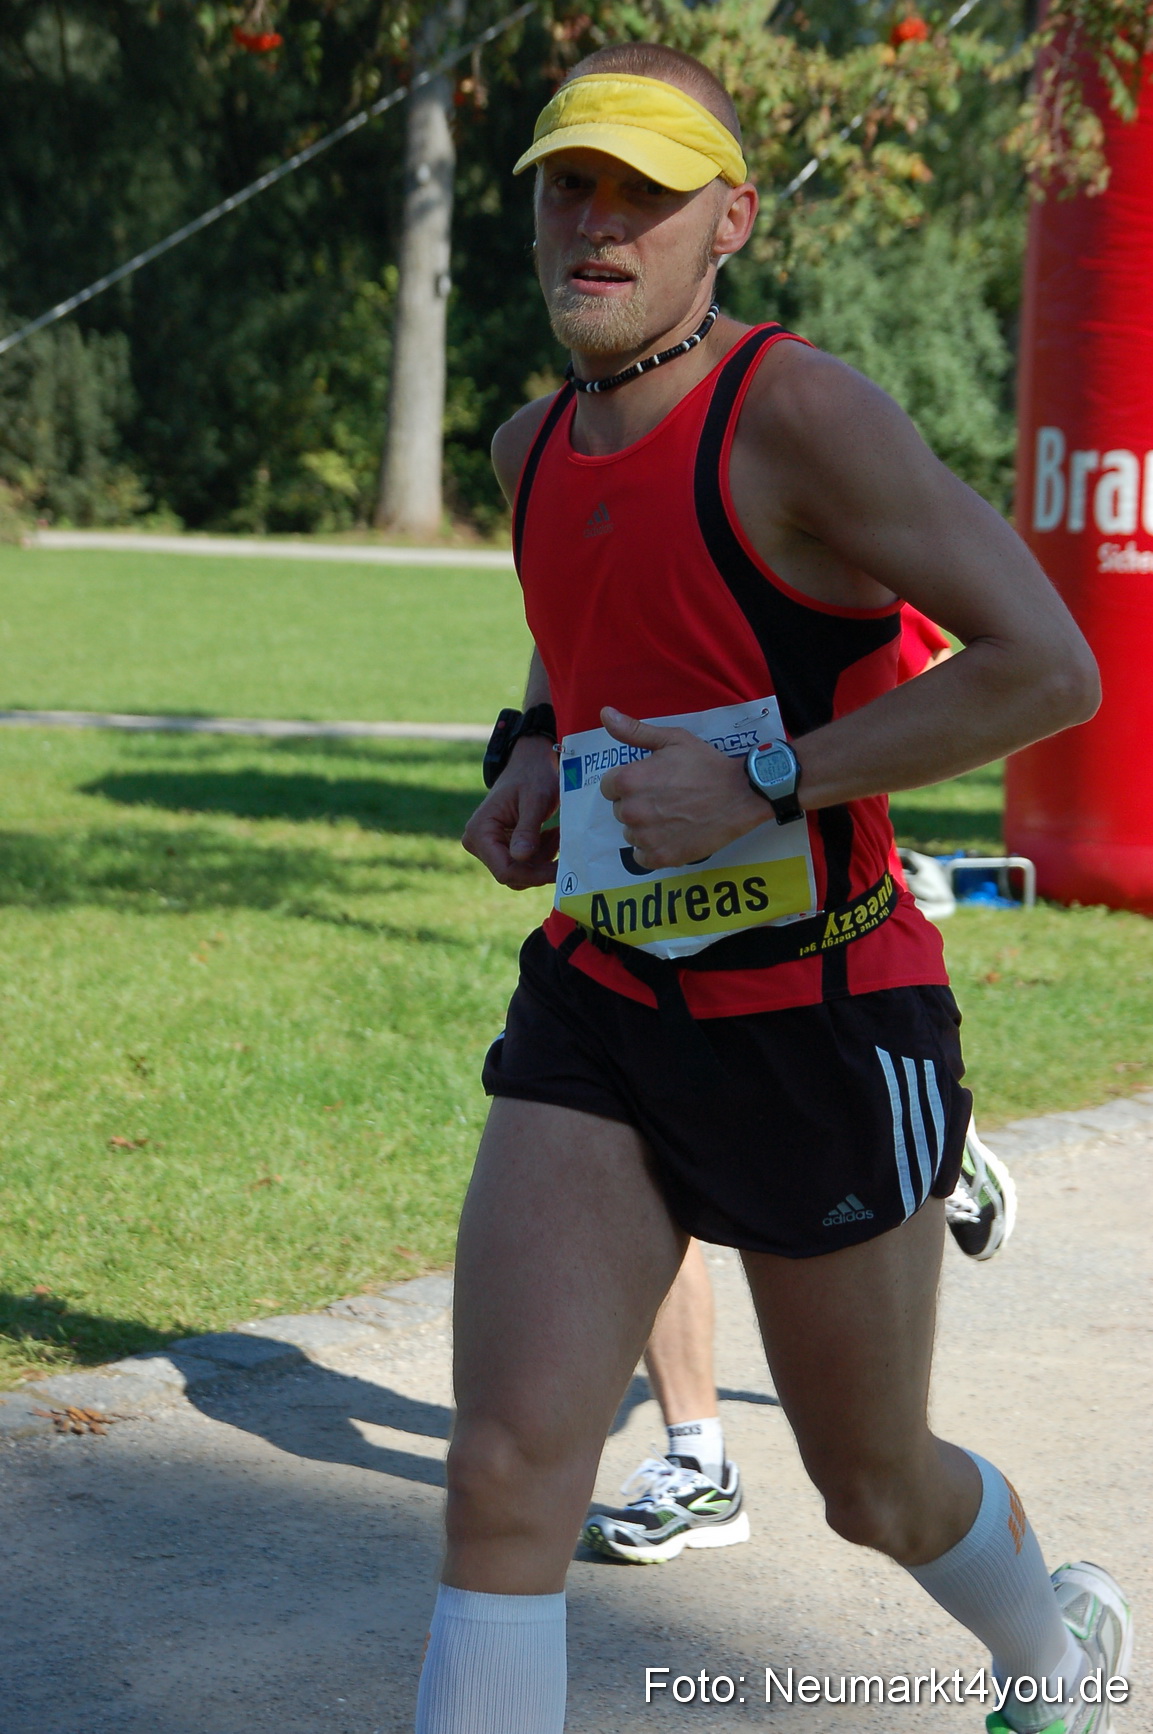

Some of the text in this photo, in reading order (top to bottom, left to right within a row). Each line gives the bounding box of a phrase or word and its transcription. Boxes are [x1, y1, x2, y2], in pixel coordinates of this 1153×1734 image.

[565, 876, 573, 891] A
[591, 876, 769, 937] Andreas
[822, 1209, 874, 1227] adidas
